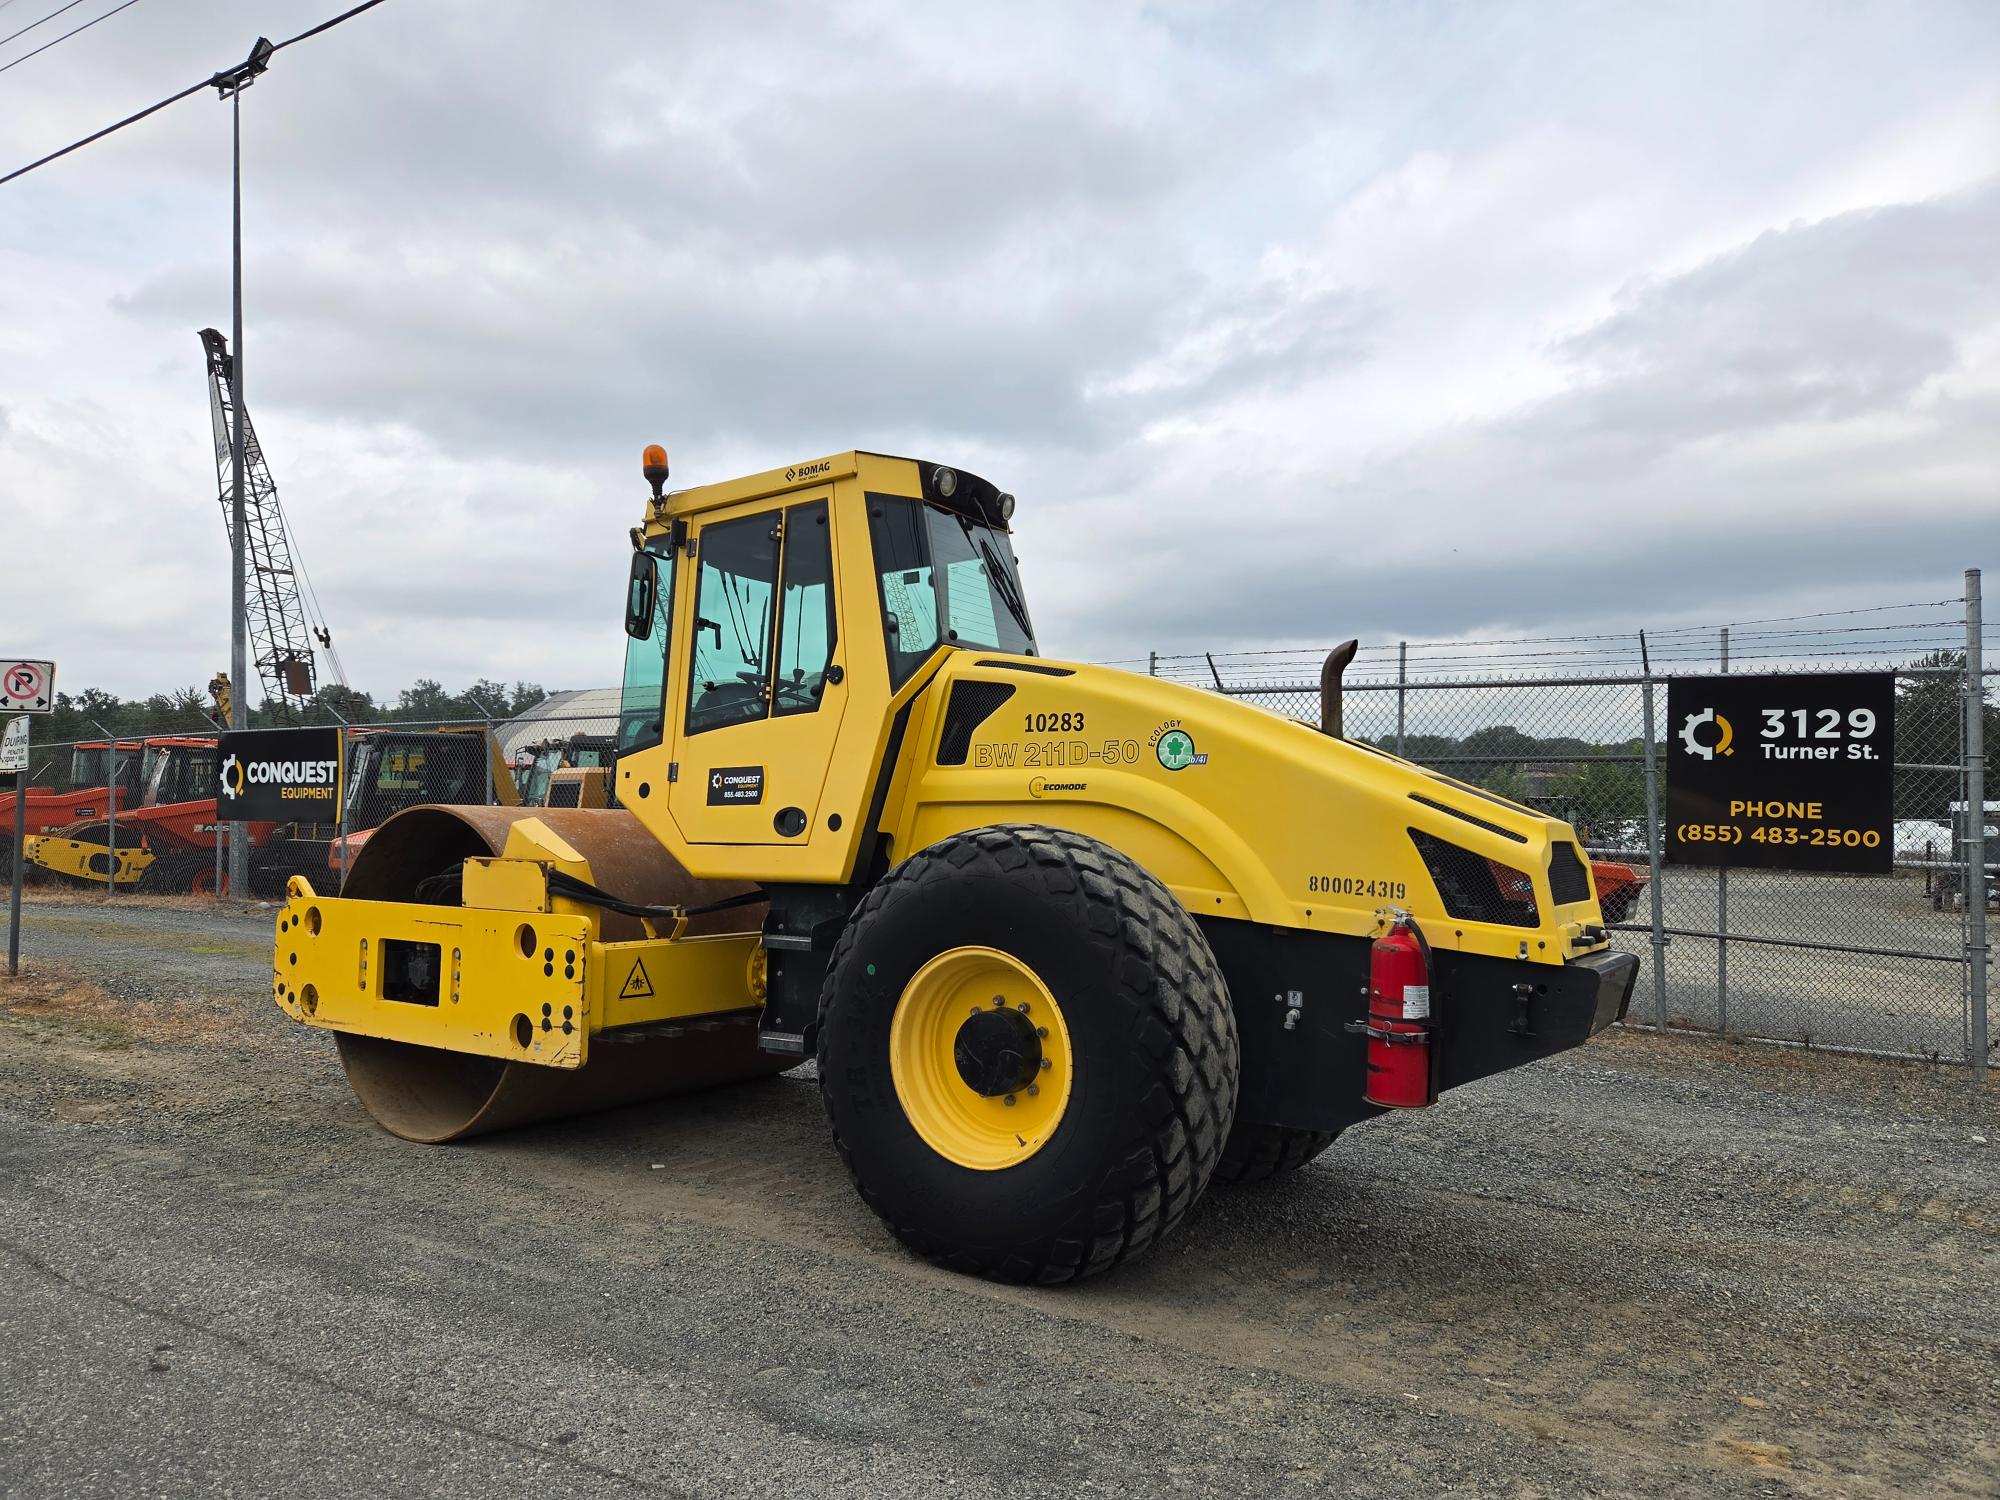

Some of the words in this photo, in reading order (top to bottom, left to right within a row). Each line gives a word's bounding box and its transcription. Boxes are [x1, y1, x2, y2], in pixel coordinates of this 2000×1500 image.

[798, 461, 830, 477] BOMAG
[1024, 712, 1085, 733] 10283
[1147, 719, 1182, 747] ECOLOGY
[1759, 708, 1877, 739] 3129
[975, 742, 1018, 767] BW
[1024, 739, 1140, 766] 211D-50
[1760, 743, 1839, 760] Turner
[1847, 744, 1879, 760] St.
[247, 760, 338, 784] CONQUEST
[724, 775, 761, 785] CONQUEST
[281, 787, 334, 799] EQUIPMENT
[1043, 783, 1087, 791] ECOMODE
[1730, 800, 1823, 820] PHONE
[1677, 824, 1743, 845] (855)
[1751, 826, 1881, 848] 483-2500
[1309, 876, 1406, 899] 800024319
